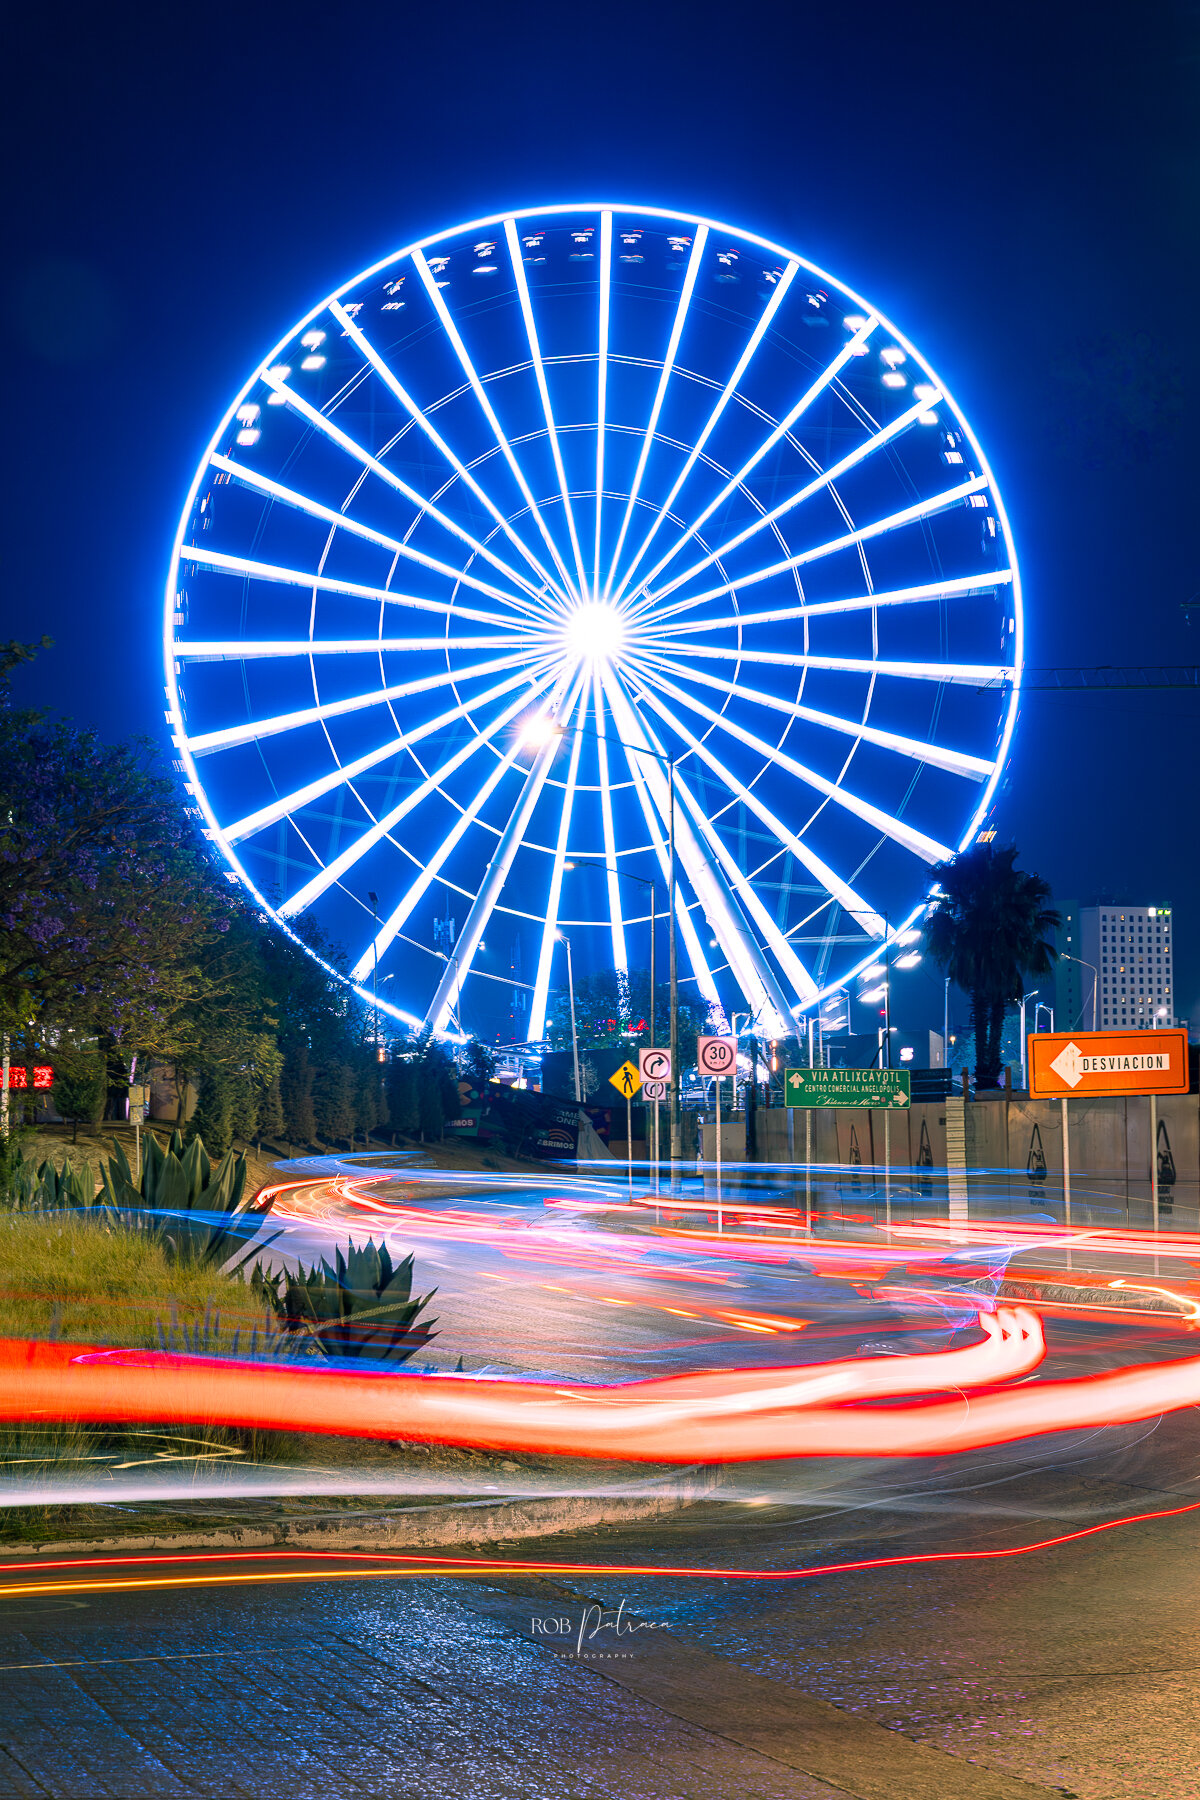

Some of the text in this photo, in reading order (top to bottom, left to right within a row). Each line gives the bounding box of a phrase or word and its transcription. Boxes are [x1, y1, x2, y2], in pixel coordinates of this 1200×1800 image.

[710, 1046, 726, 1060] 30
[1083, 1055, 1163, 1071] DESVIACION
[811, 1071, 901, 1083] VIA ATLIXCAYOTL
[804, 1084, 900, 1094] CENTRO COMERCIAL ANGELOPOLIS
